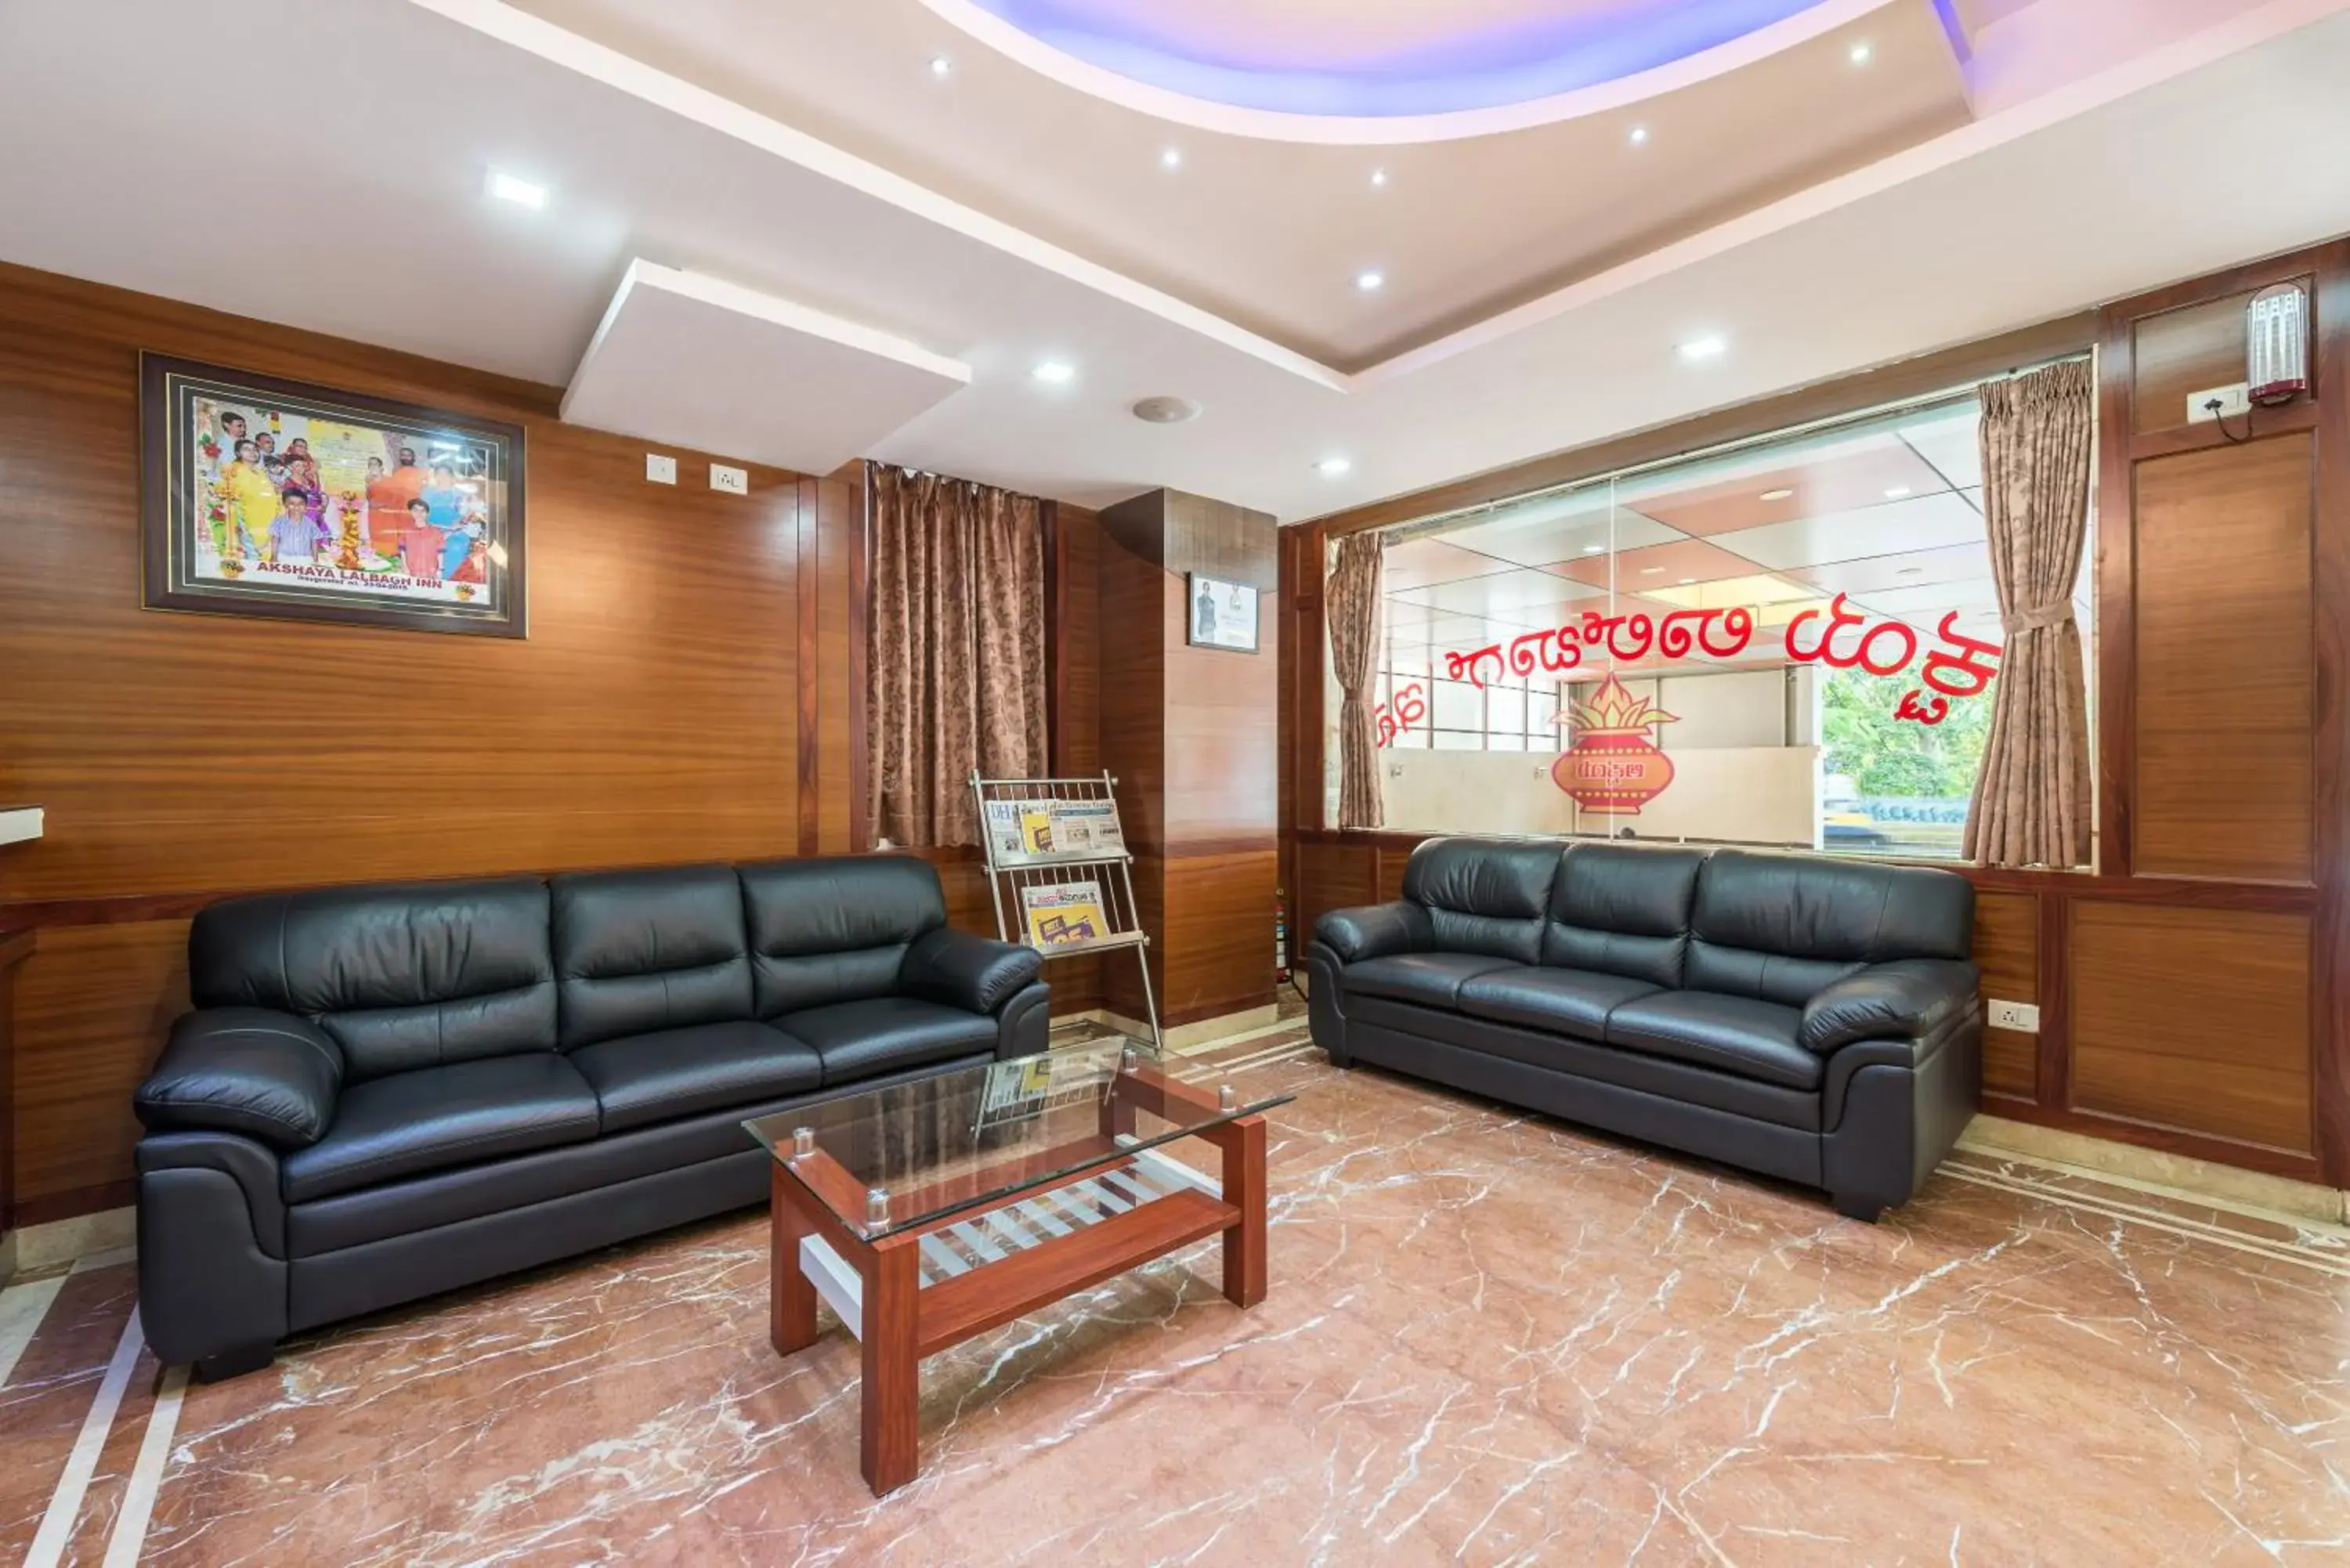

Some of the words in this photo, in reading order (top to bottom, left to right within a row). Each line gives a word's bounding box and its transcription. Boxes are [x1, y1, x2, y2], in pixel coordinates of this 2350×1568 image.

[257, 562, 334, 576] AKSHAYA
[340, 570, 411, 586] LALBAGH
[416, 578, 443, 589] INN
